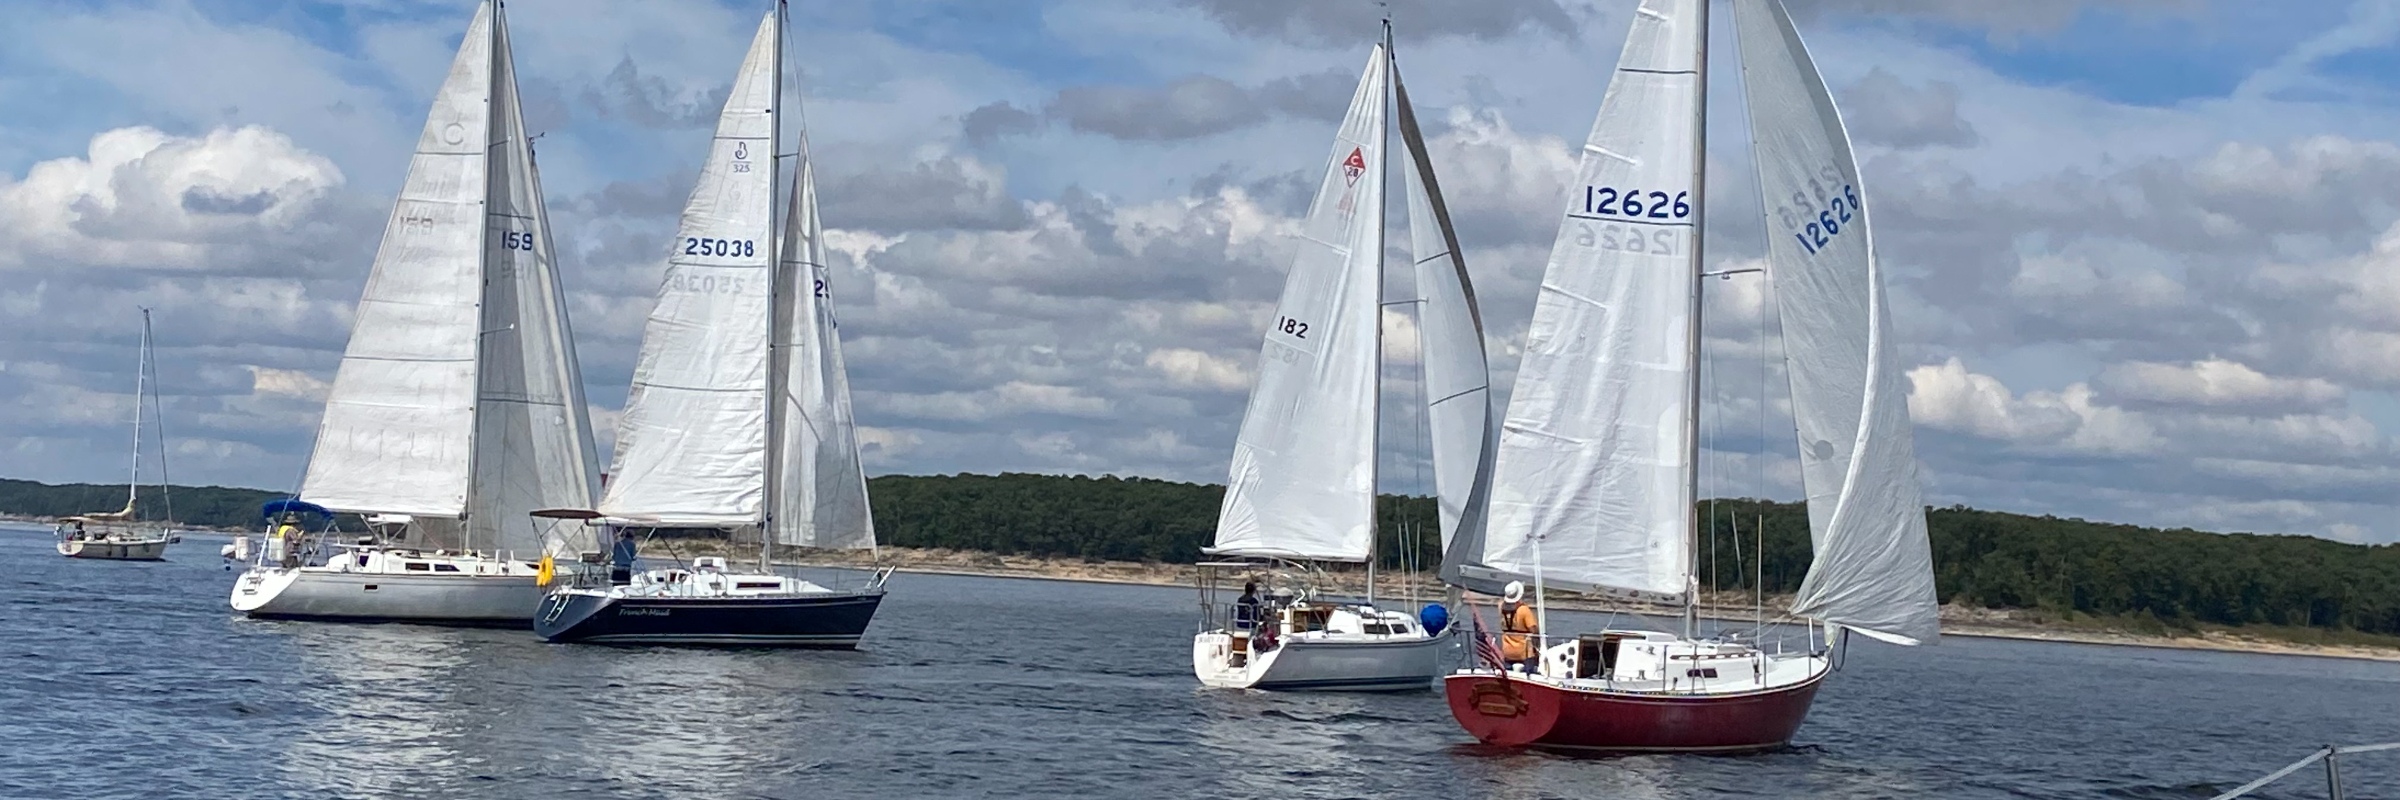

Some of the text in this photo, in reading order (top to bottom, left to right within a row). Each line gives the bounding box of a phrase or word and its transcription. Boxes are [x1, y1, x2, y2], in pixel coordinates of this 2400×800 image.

[733, 164, 751, 173] 325
[1350, 155, 1361, 165] C
[1347, 166, 1359, 178] 28
[1586, 185, 1690, 219] 12626
[1795, 184, 1858, 256] 12626
[502, 231, 533, 250] 159
[685, 237, 754, 257] 25038
[1278, 315, 1309, 339] 182
